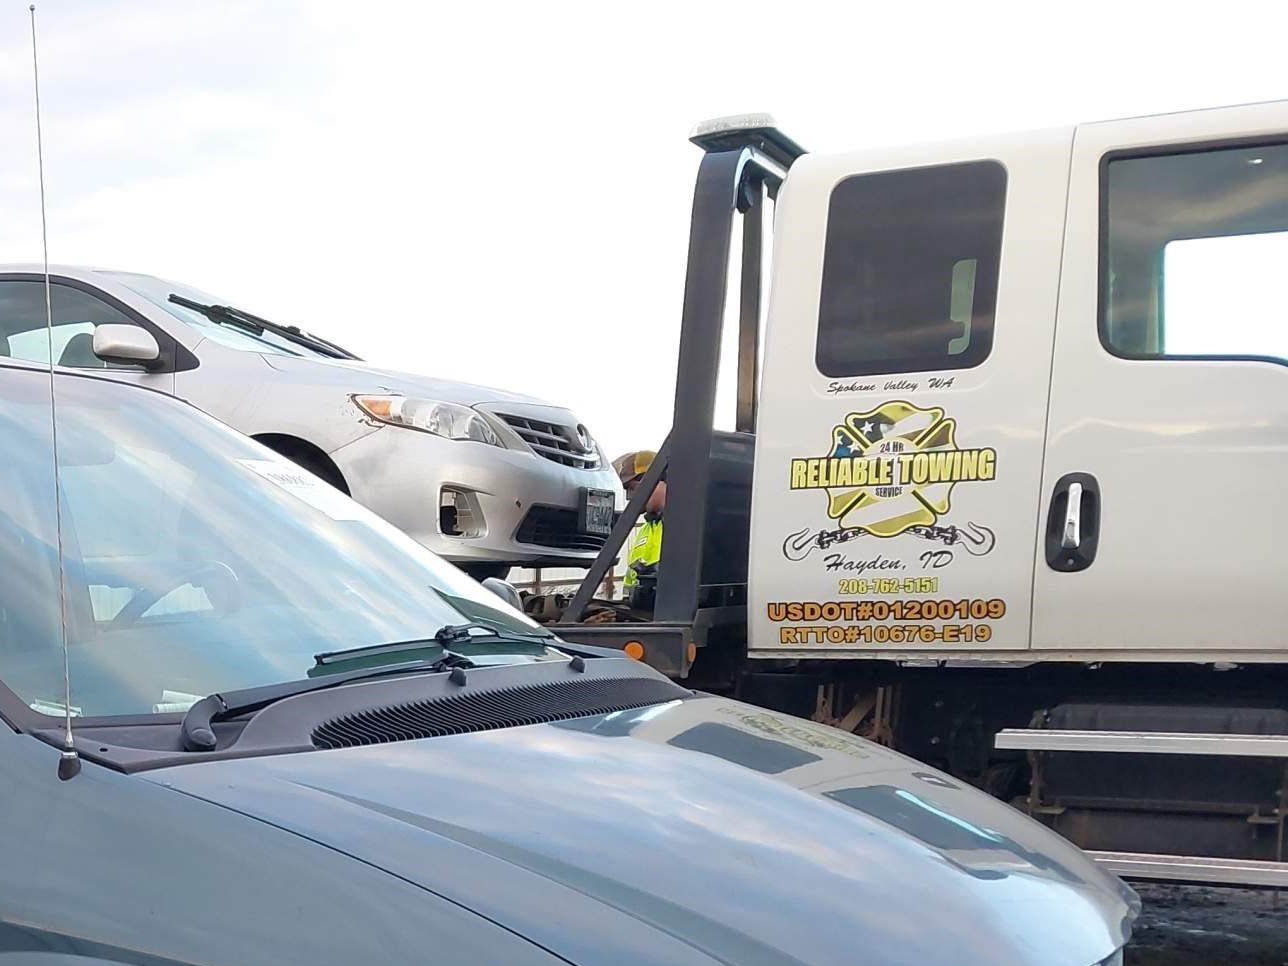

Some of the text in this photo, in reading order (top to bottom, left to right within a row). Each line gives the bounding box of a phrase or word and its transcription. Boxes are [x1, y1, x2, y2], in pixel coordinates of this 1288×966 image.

[827, 377, 955, 395] Spokane Valley WA
[880, 441, 904, 453] 24 HR
[790, 448, 997, 490] RELIABLE TOWING
[875, 487, 903, 498] SERVICE
[823, 551, 954, 573] Hayden, ID
[838, 577, 938, 594] 208-762-5151
[767, 599, 1006, 622] USDOT#01200109
[780, 625, 991, 644] RTTO#10676-E19
